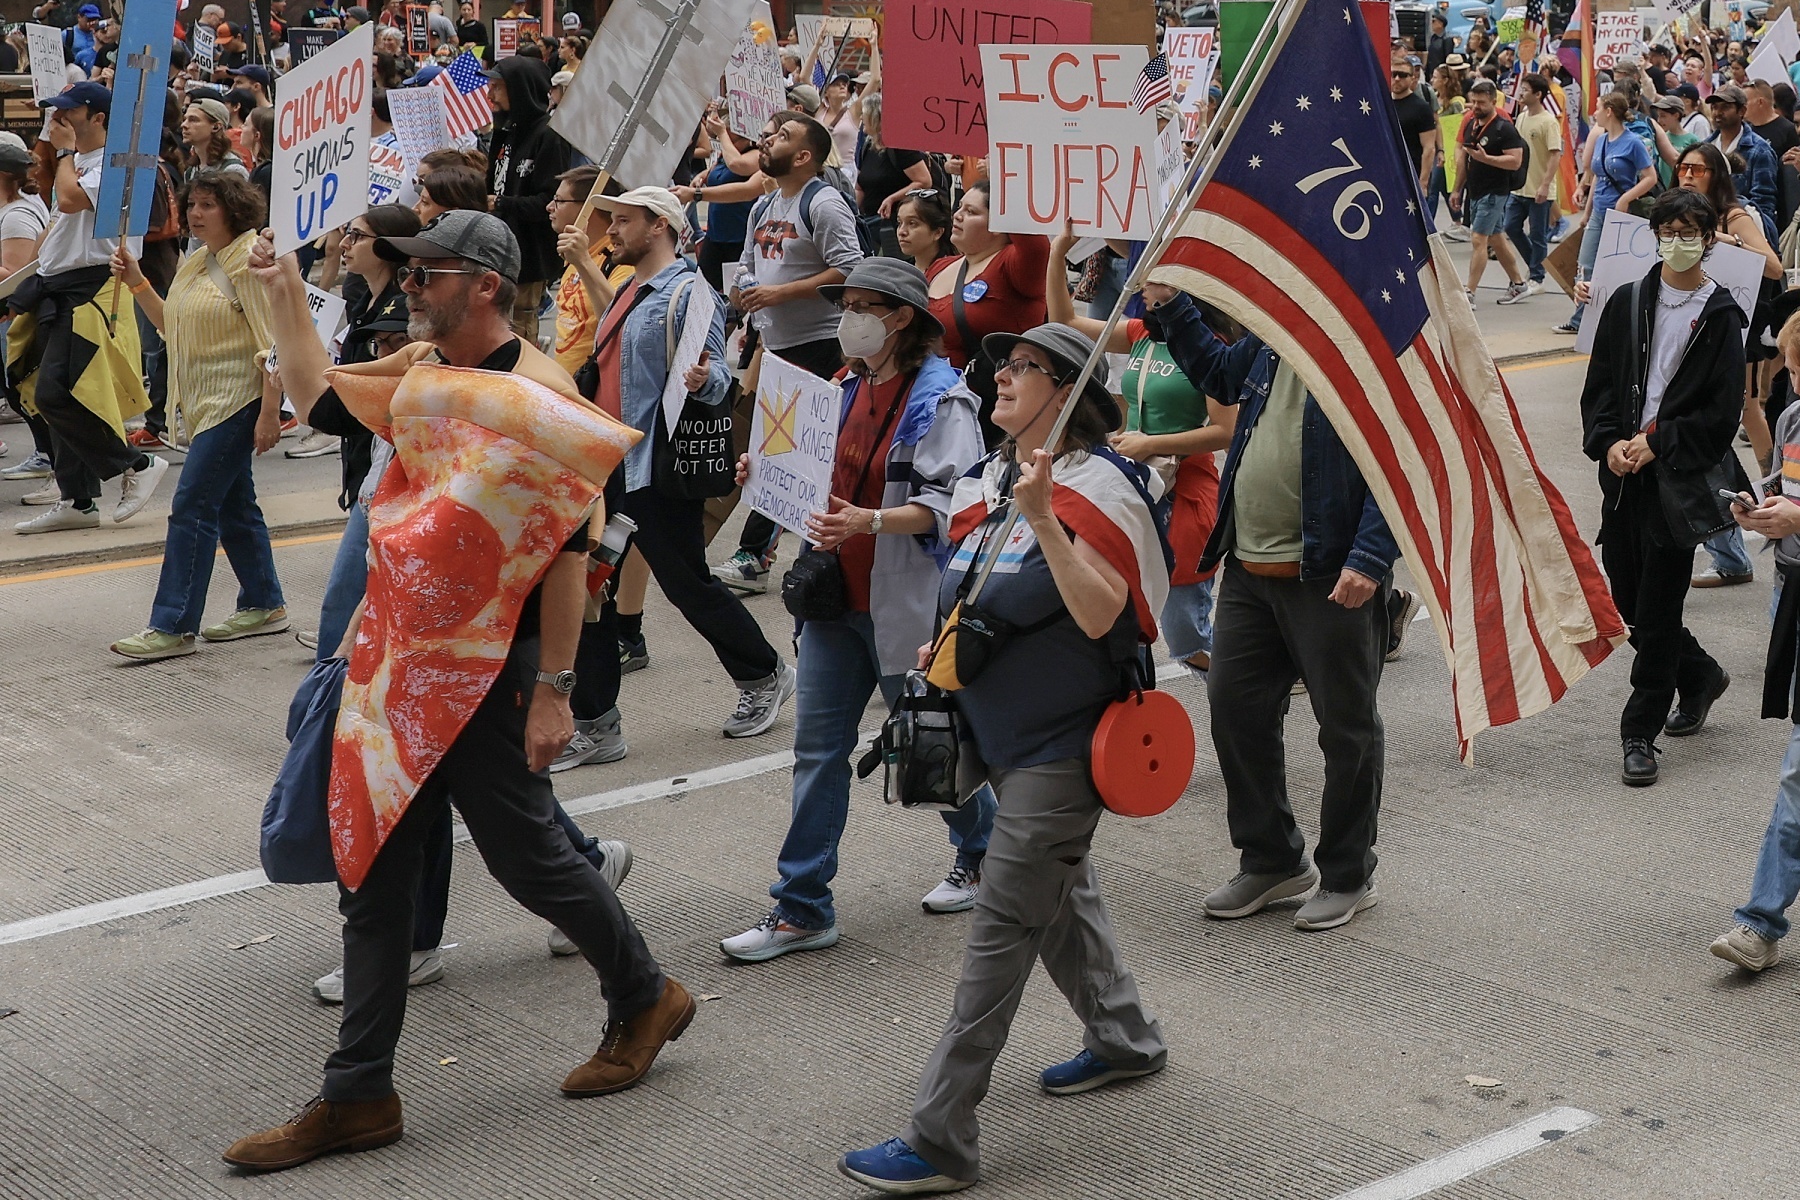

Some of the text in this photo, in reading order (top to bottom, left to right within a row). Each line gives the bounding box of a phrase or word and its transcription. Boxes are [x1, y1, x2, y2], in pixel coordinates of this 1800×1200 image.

[912, 4, 1060, 48] UNITED
[1598, 29, 1641, 39] MY CITY
[1601, 15, 1638, 25] I TAKE
[29, 33, 47, 53] THIS
[202, 32, 213, 46] OFF
[306, 35, 324, 45] MAKE
[1168, 33, 1212, 59] VETO
[1606, 42, 1632, 54] NEAT
[730, 73, 783, 105] TOLERATE
[998, 52, 1133, 112] I.C.E.
[278, 57, 364, 151] CHICAGO
[923, 96, 988, 137] STA
[292, 126, 355, 191] SHOWS
[1161, 135, 1171, 157] NO
[996, 142, 1154, 233] FUERA
[1295, 138, 1384, 240] 76
[296, 172, 338, 240] UP
[1602, 221, 1652, 259] IC
[307, 292, 326, 313] OFF
[1127, 356, 1175, 377] MEICO
[810, 391, 830, 423] NO
[679, 417, 733, 436] WOULD
[800, 423, 835, 465] KINGS
[706, 457, 729, 474] TO.
[758, 458, 817, 505] PROTECT OUR
